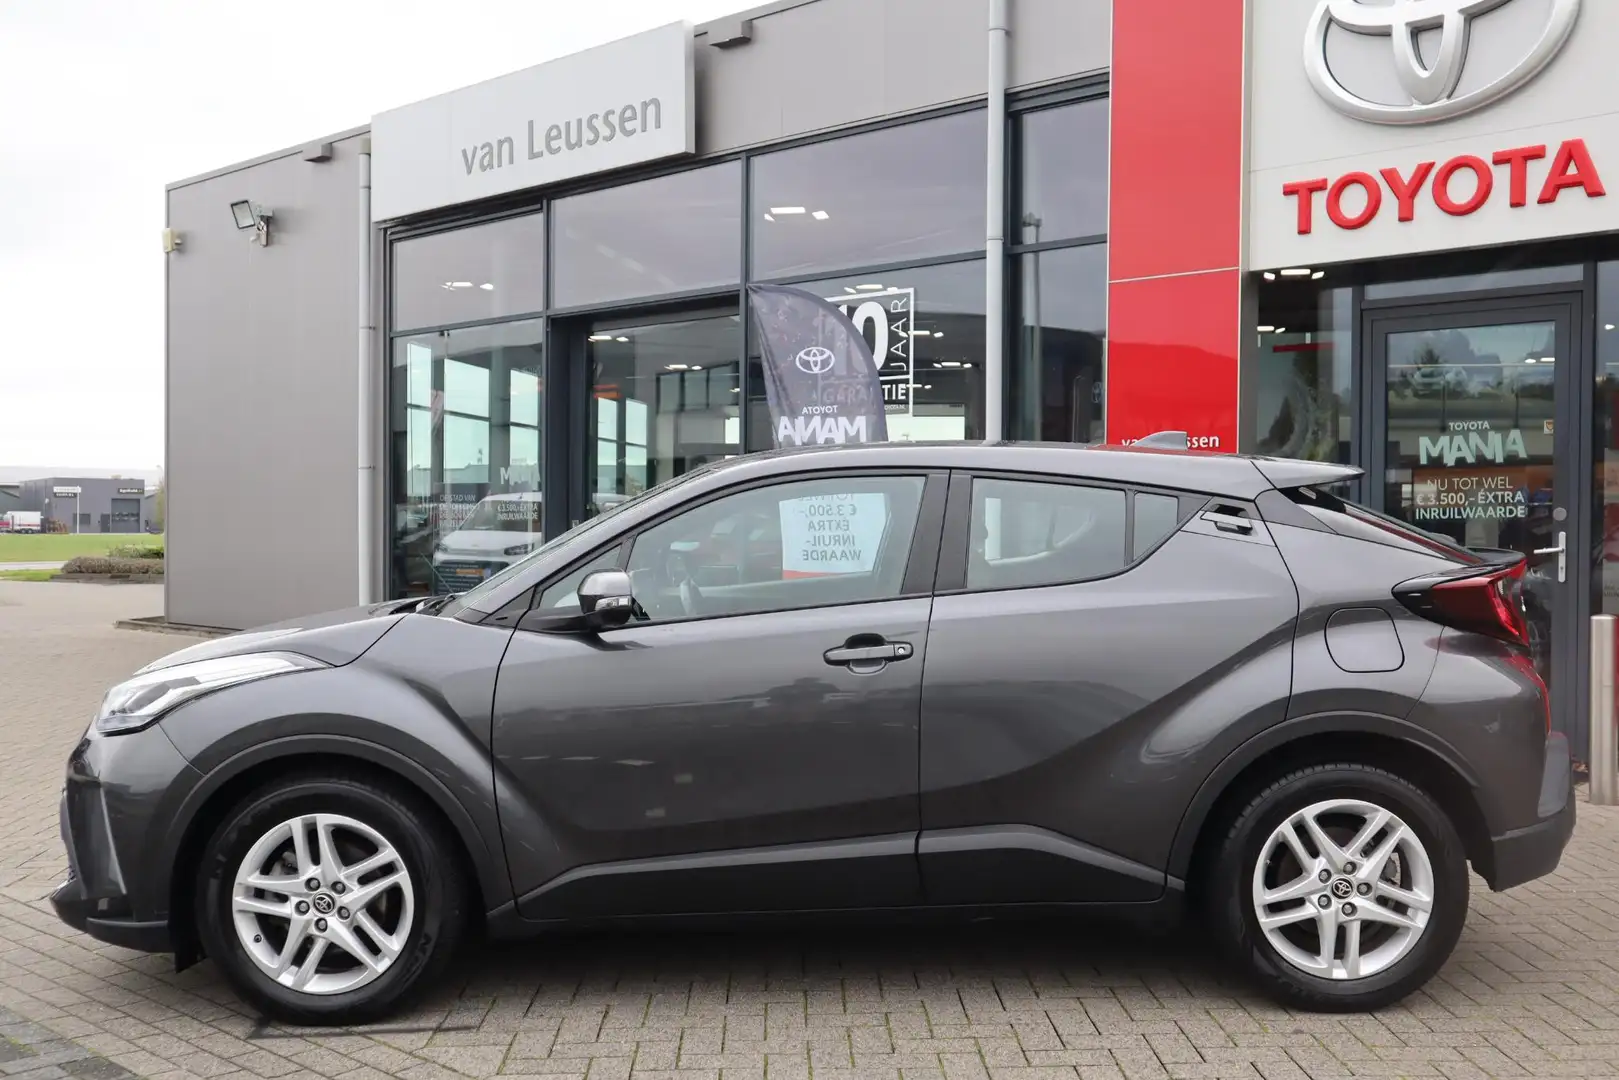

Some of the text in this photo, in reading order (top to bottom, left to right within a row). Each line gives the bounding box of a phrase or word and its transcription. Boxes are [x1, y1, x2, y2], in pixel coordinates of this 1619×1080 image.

[462, 97, 661, 175] van Leussen
[1282, 138, 1606, 235] TOYOTA
[890, 297, 907, 372] JAAR
[1449, 420, 1491, 431] TOYOTA
[1418, 428, 1528, 467] MANIA
[1427, 476, 1514, 491] NU TOT WEL
[1415, 505, 1527, 520] INRUILWAARDE
